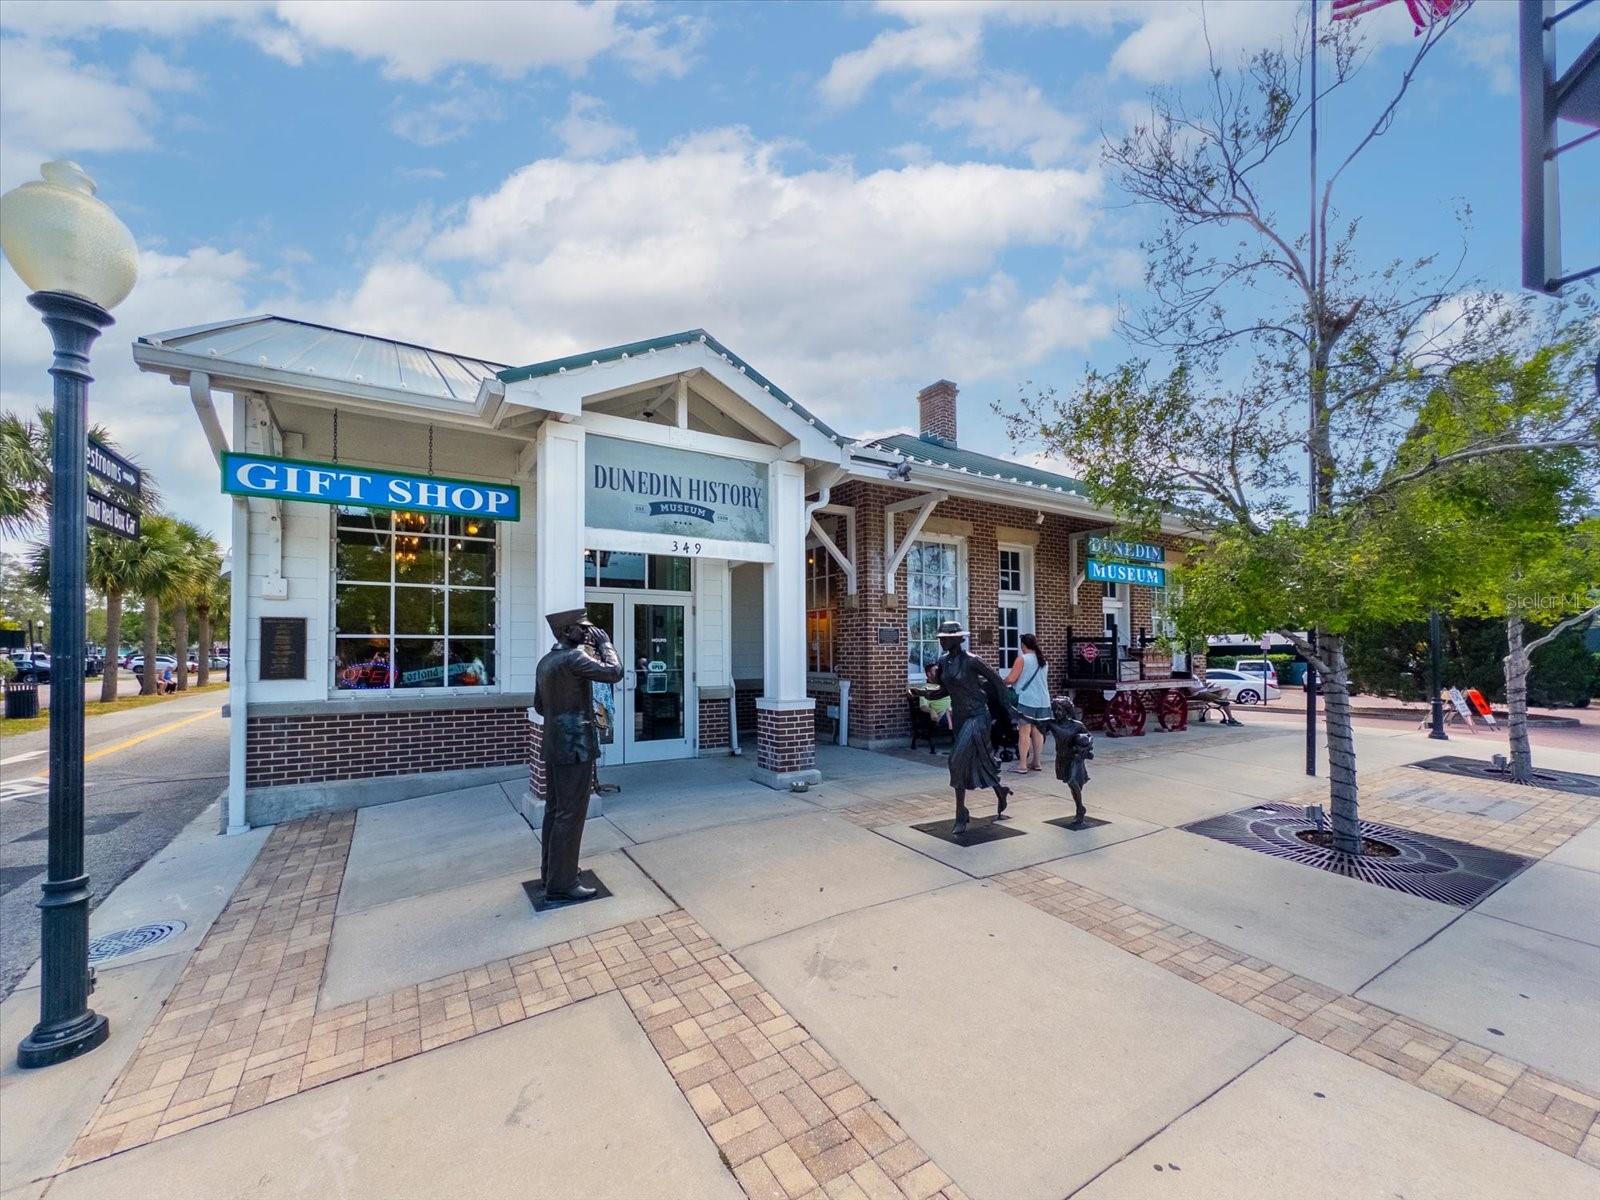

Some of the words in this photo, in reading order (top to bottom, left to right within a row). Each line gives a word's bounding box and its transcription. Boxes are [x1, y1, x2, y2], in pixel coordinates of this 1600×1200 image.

[87, 447, 121, 482] estrooms
[236, 463, 372, 499] GIFT
[388, 479, 510, 513] SHOP
[594, 464, 682, 499] DUNEDIN
[688, 478, 762, 509] HISTORY
[101, 500, 113, 527] Red
[126, 513, 136, 535] Car
[660, 503, 706, 517] MUSEUM
[671, 540, 702, 555] 349
[1093, 562, 1159, 584] MUSEUM
